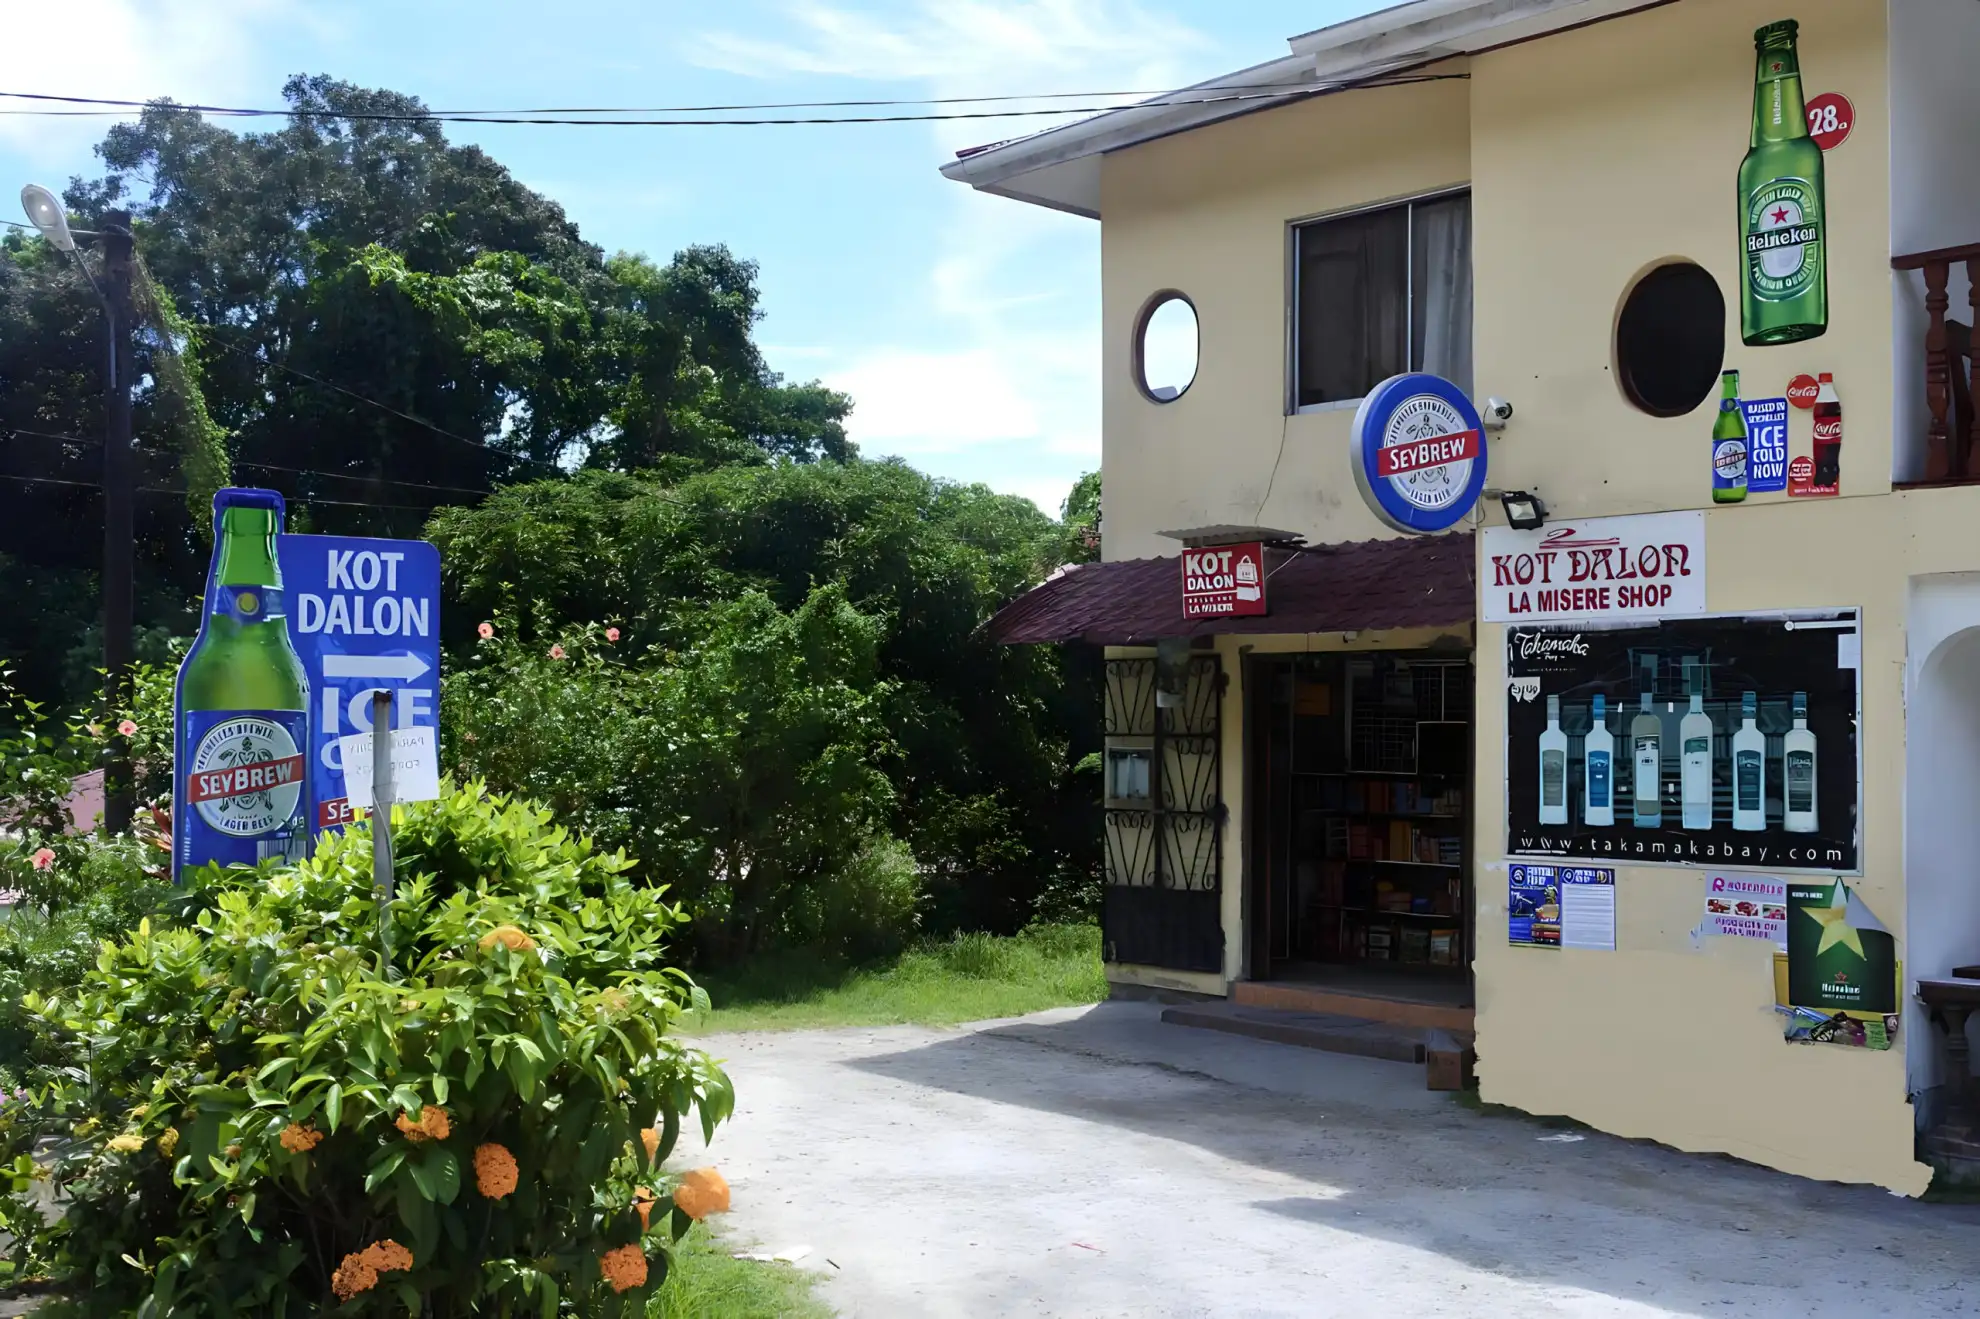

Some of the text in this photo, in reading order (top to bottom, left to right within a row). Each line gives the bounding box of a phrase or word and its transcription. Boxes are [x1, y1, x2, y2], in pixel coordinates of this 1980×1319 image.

[1748, 228, 1816, 251] Heineken
[1753, 425, 1784, 448] ICE
[1753, 448, 1784, 463] COLD
[1753, 463, 1784, 479] NOW
[327, 549, 404, 592] KOT
[1185, 551, 1233, 576] KOT
[1491, 544, 1691, 586] KOT DALON
[1187, 574, 1234, 591] DALON
[1509, 584, 1672, 613] LA MISERE SHOP
[298, 594, 429, 637] DALON
[322, 687, 433, 734] ICE
[199, 761, 293, 796] SEYBREW
